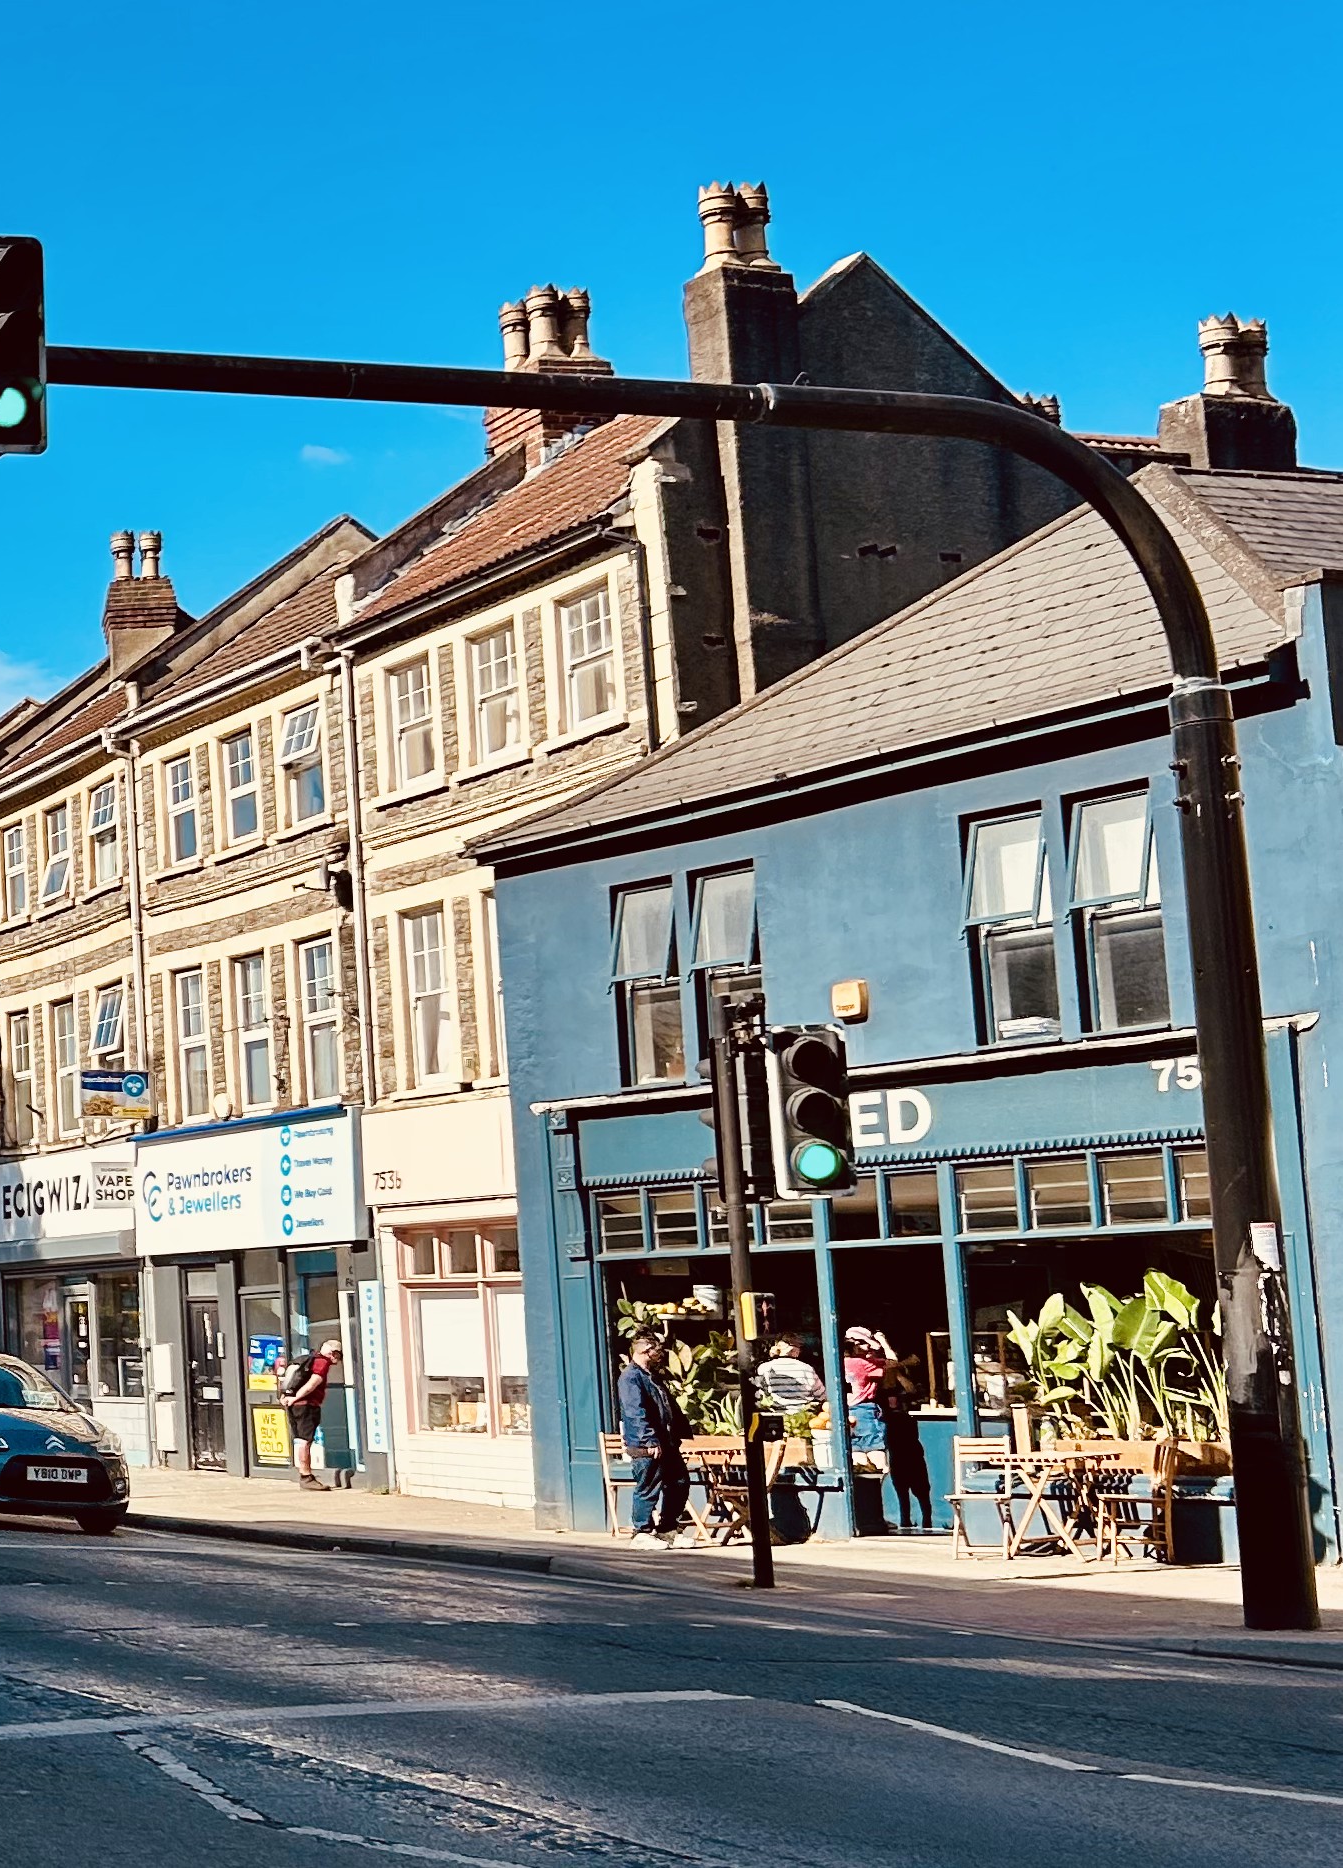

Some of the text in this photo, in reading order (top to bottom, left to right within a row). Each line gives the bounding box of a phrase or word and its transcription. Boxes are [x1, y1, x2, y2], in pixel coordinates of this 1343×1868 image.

[1151, 1055, 1203, 1093] 75
[848, 1088, 933, 1148] ED
[96, 1175, 133, 1186] VAPE
[166, 1164, 252, 1191] Pawnbrokers
[373, 1169, 402, 1190] 753b
[95, 1189, 135, 1201] SHOP
[168, 1191, 242, 1216] & Jewellers
[261, 1413, 277, 1426] WE
[260, 1427, 278, 1439] BUY
